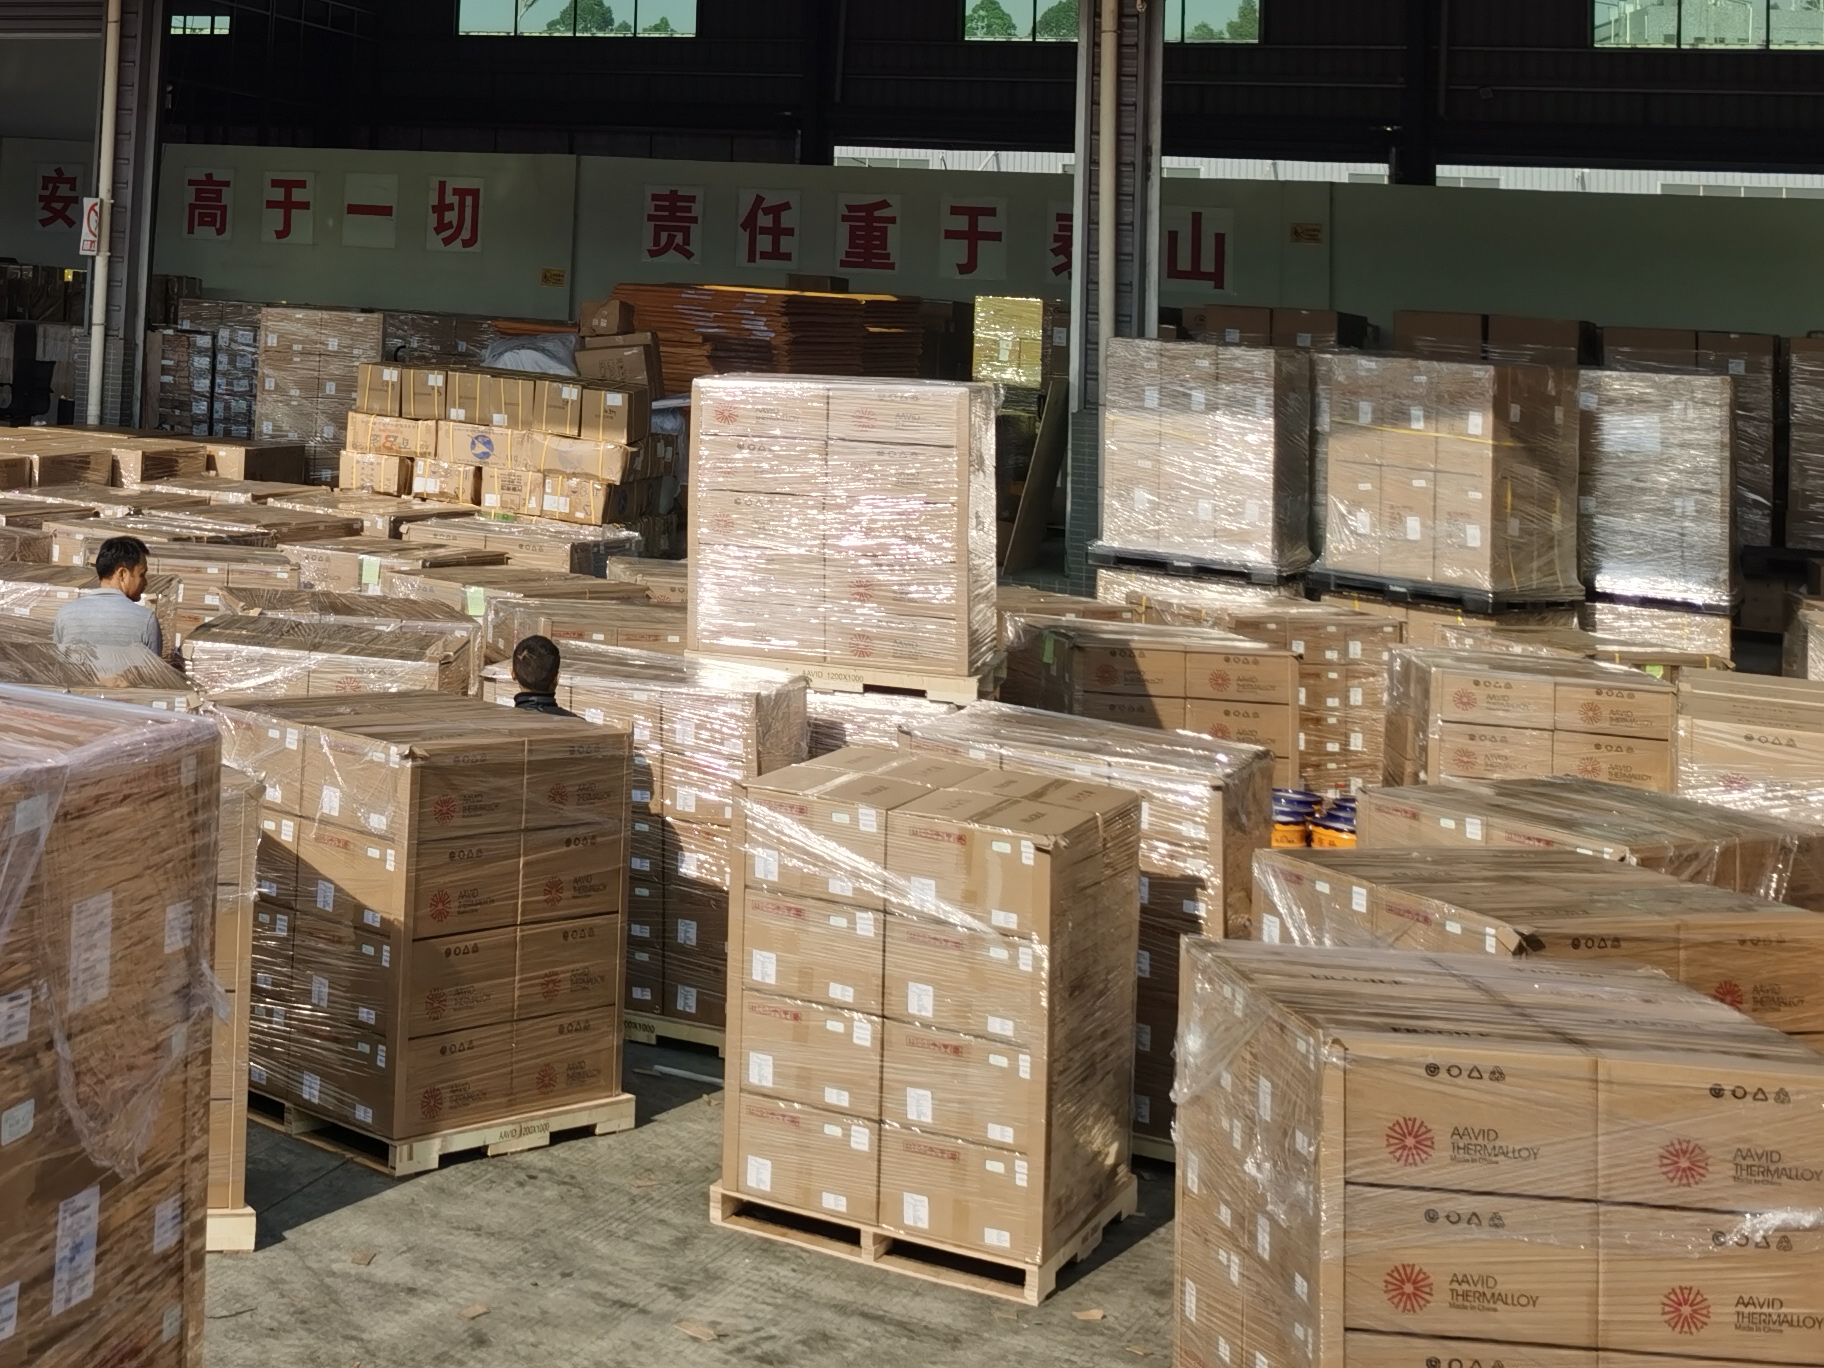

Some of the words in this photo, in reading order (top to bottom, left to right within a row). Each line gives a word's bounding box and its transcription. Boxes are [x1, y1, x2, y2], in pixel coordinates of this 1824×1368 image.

[1450, 1126, 1499, 1142] AAVID
[1450, 1141, 1541, 1161] THERMALLOY
[1733, 1147, 1782, 1164] AAVID
[1733, 1162, 1824, 1182] THERMALLOY
[1449, 1272, 1498, 1289] AAVID
[1449, 1288, 1540, 1308] THERMALLOY
[1734, 1295, 1784, 1310] AAVID
[1734, 1310, 1824, 1330] THERMALLOY
